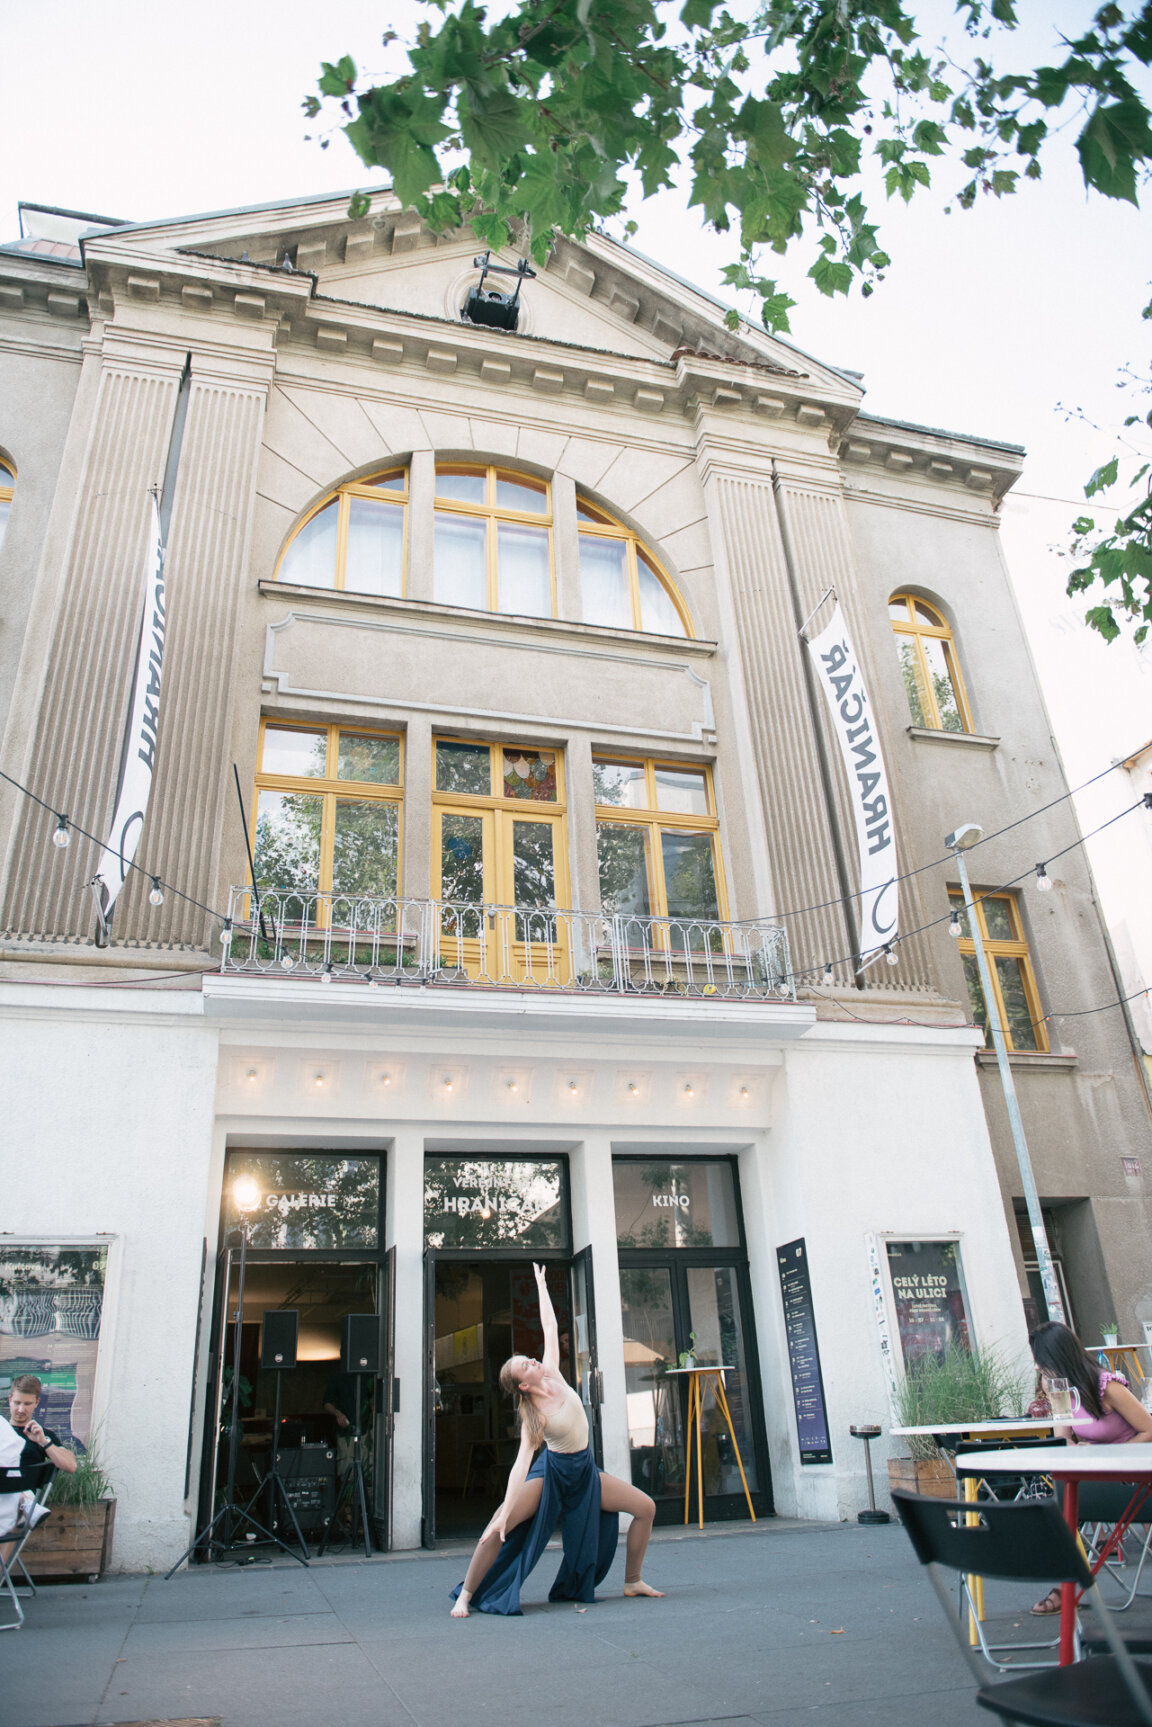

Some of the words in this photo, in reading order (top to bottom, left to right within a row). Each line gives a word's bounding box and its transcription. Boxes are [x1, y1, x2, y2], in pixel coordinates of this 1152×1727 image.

[266, 1194, 337, 1208] GALERIE
[652, 1195, 690, 1207] KINO
[893, 1274, 920, 1287] CELÝ
[922, 1273, 948, 1286] LÉTO
[898, 1289, 915, 1299] NA
[916, 1288, 947, 1298] ULICI
